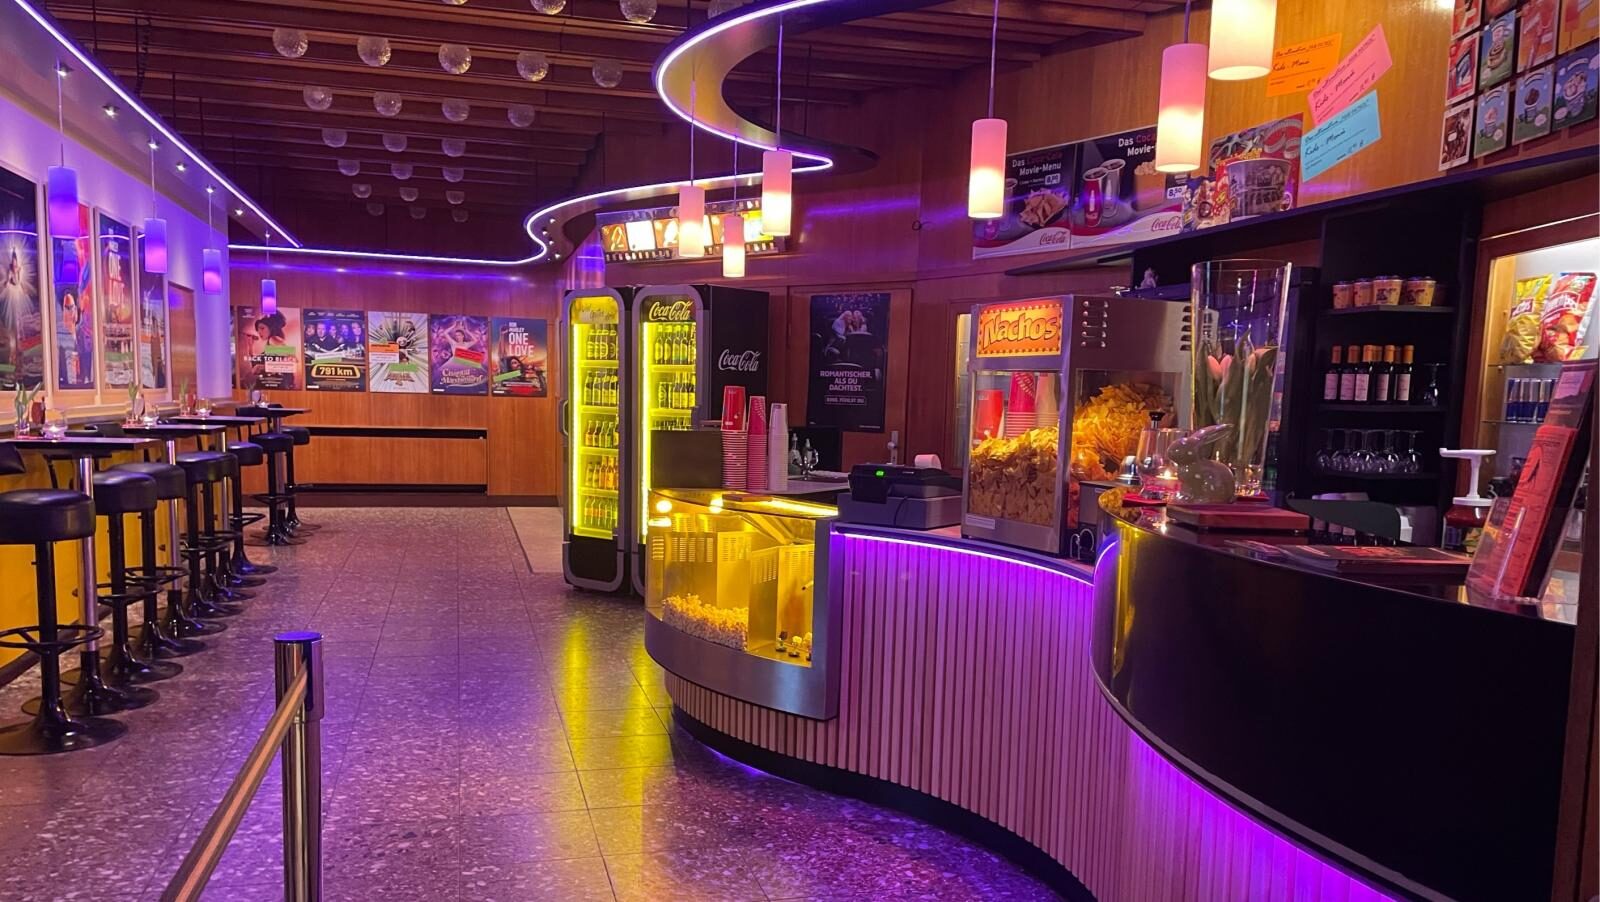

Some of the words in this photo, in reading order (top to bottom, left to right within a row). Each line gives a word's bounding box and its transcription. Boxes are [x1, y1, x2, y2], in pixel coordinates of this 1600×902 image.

[1118, 138, 1134, 148] Das
[1012, 159, 1025, 168] Das
[983, 312, 1058, 349] Nachos
[508, 332, 529, 345] ONE
[508, 344, 535, 357] LOVE
[319, 366, 336, 376] 791
[337, 367, 353, 376] km
